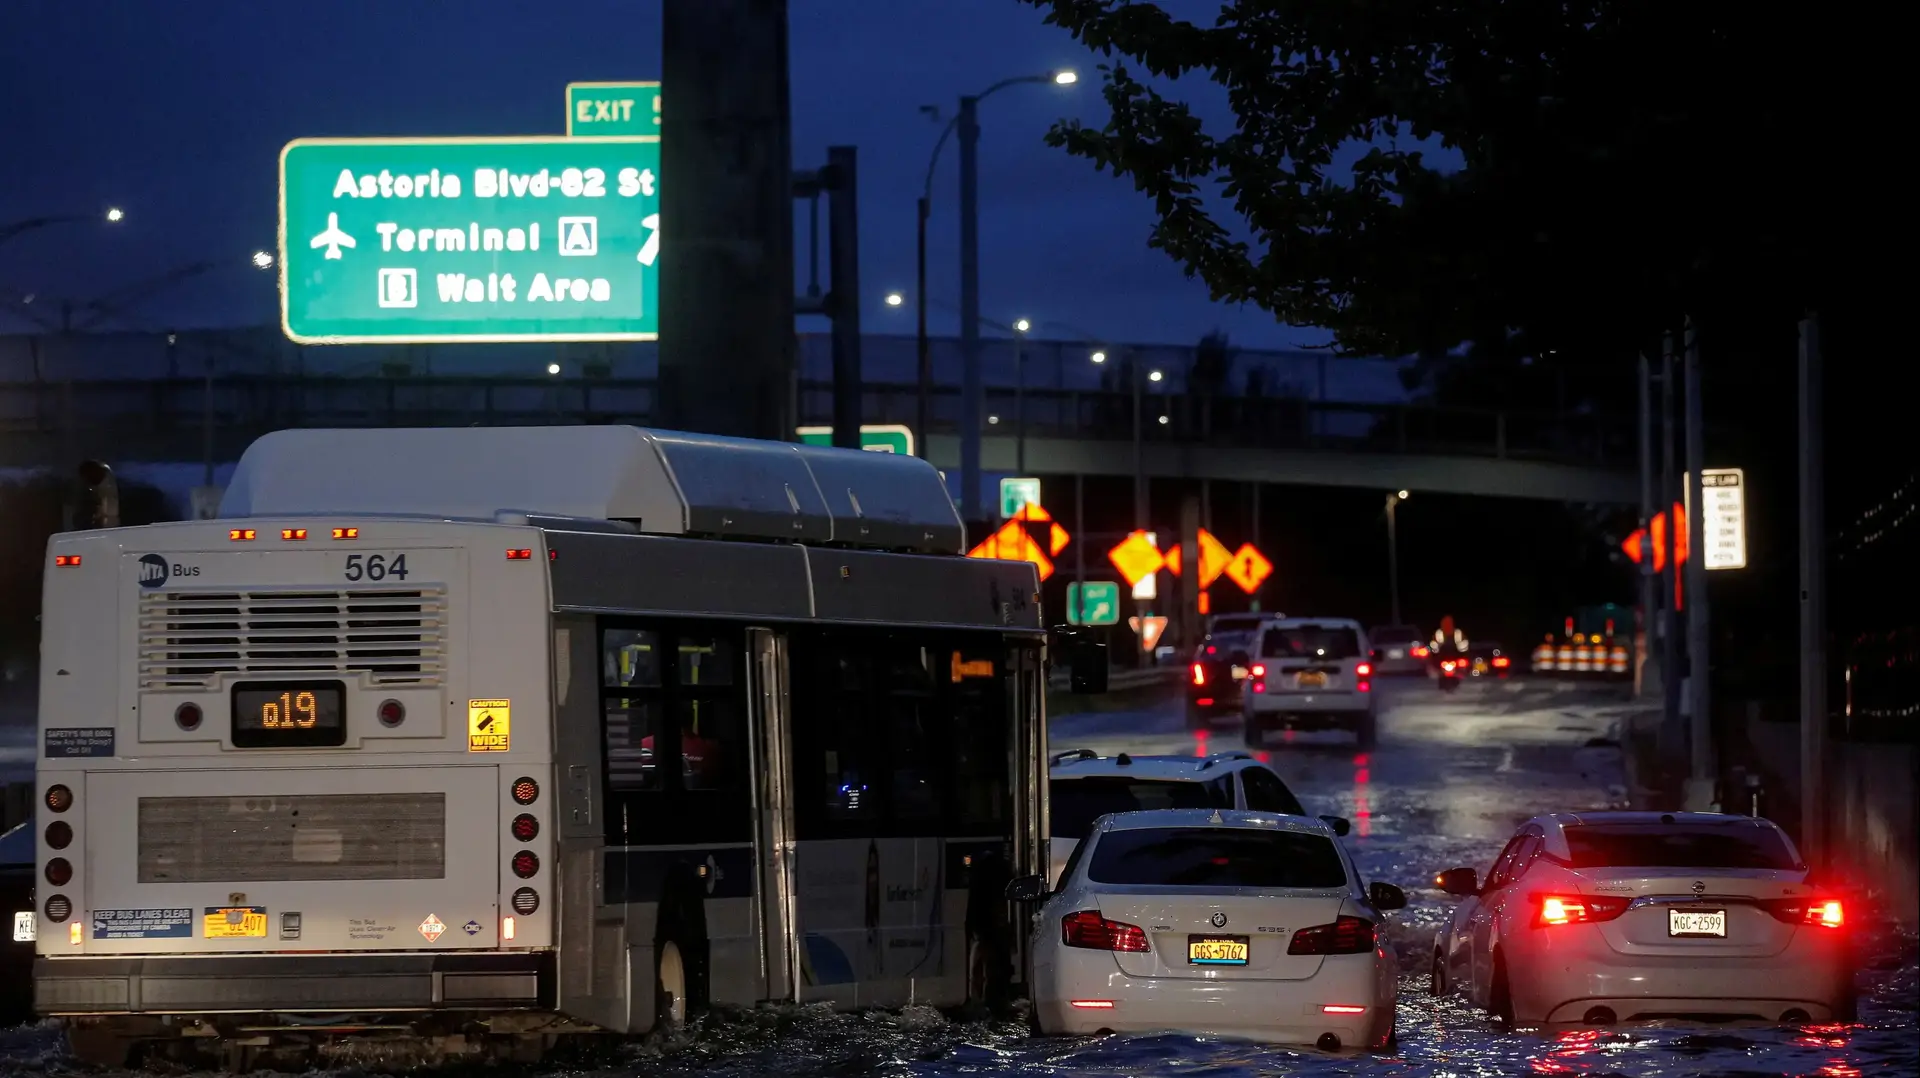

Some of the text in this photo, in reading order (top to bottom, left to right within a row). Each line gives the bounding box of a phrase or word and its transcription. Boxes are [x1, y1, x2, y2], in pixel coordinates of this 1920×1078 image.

[577, 99, 635, 122] EXIT
[333, 168, 461, 198] Astoria
[617, 168, 656, 197] St
[376, 222, 591, 251] Terminal A
[436, 273, 517, 302] Wait
[527, 273, 611, 302] Area
[138, 560, 200, 583] MTA Bus
[344, 554, 409, 581] 564
[472, 735, 507, 746] WIDE
[95, 910, 190, 919] KEEP BUS LANES CLEAR
